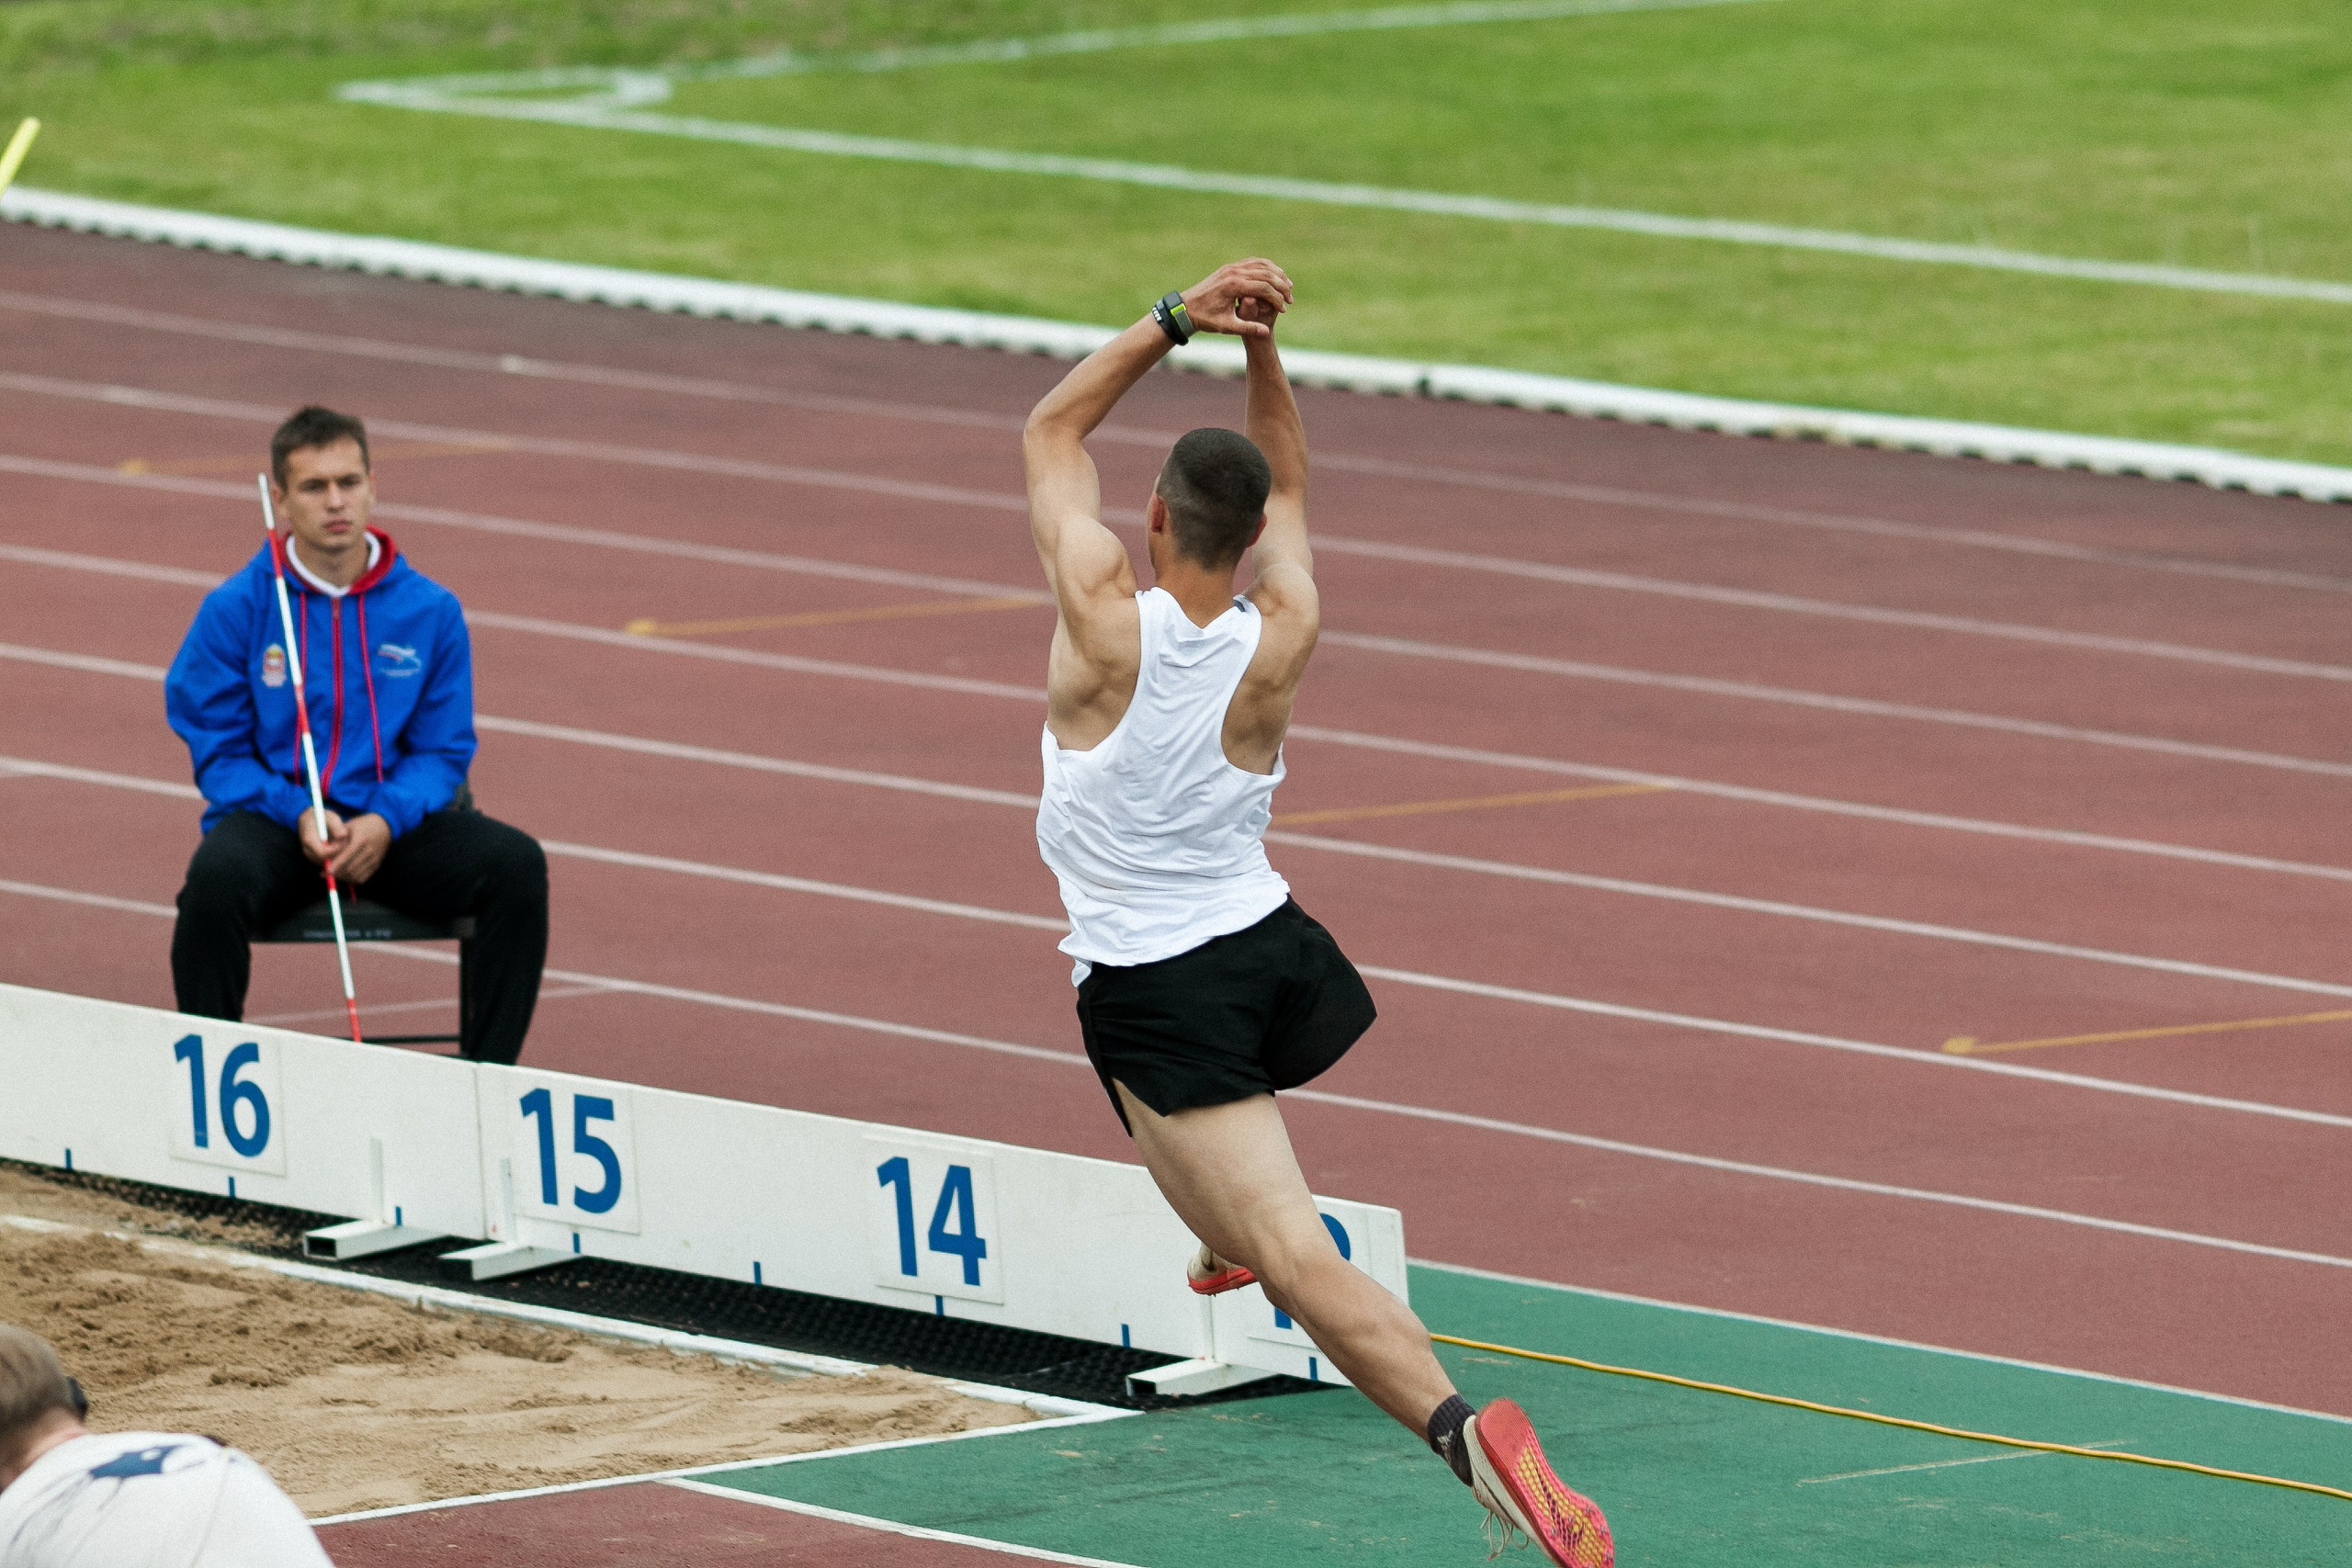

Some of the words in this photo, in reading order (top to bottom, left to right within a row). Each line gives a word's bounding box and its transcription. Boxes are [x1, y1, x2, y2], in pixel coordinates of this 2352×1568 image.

[173, 1033, 271, 1158] 16
[519, 1088, 622, 1214] 15
[876, 1156, 987, 1287] 14
